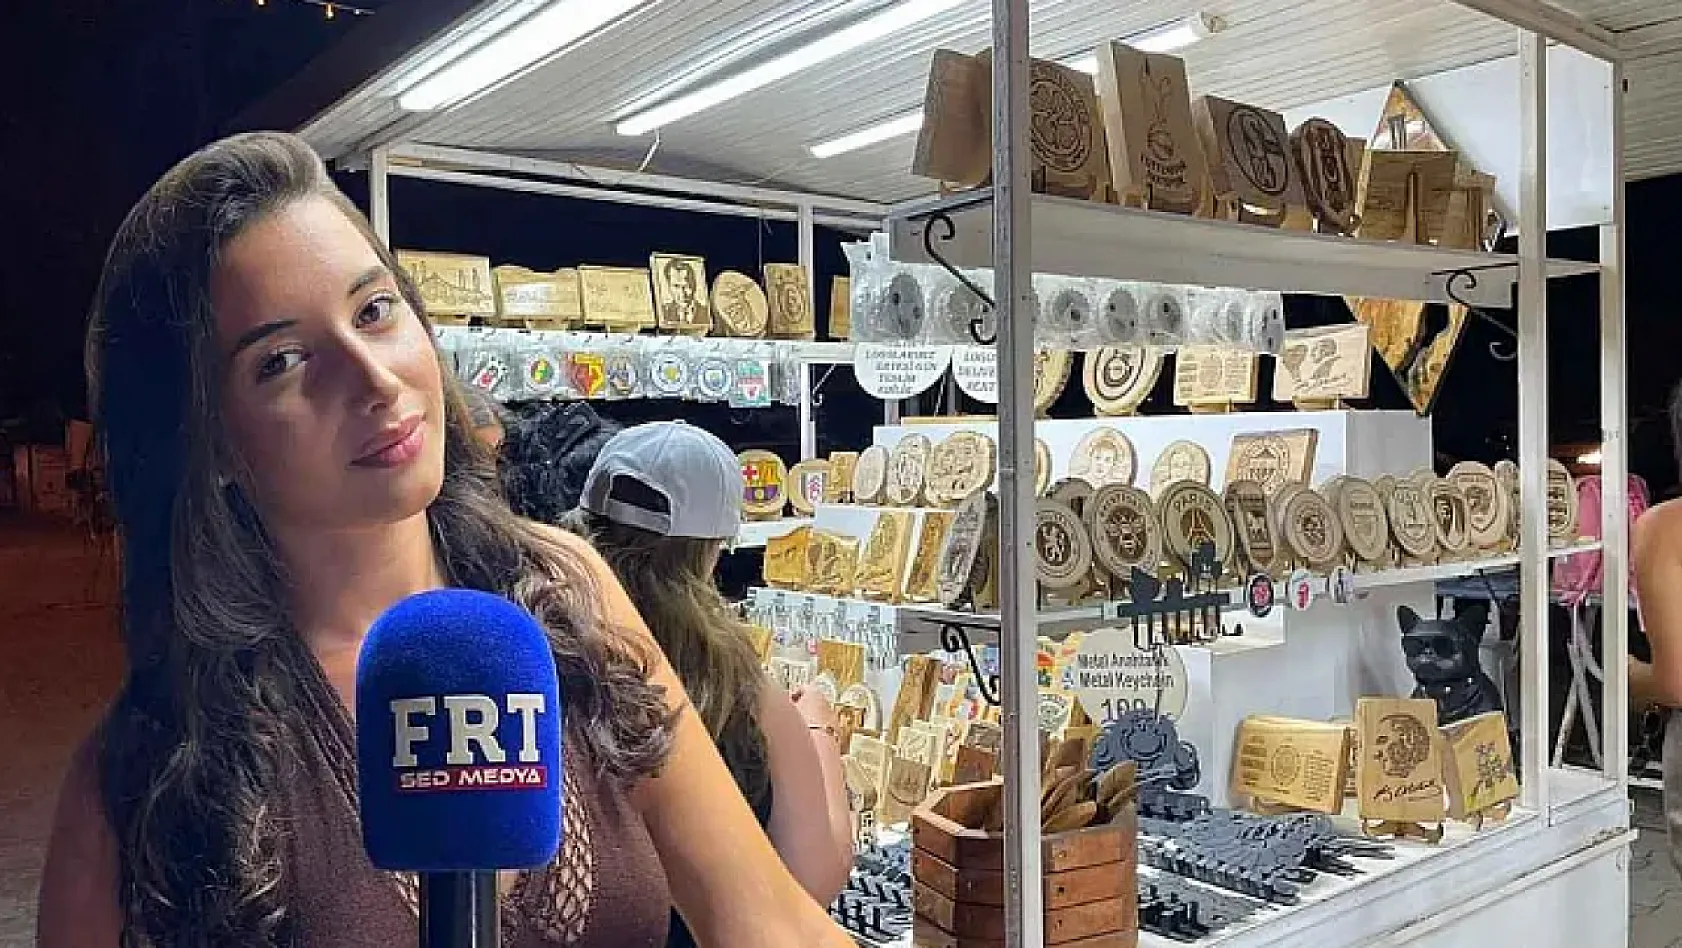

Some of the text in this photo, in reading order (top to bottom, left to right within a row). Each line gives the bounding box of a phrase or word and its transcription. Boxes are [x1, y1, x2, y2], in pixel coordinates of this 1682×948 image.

[1077, 653, 1109, 668] Metal
[1079, 672, 1113, 687] Metal
[390, 694, 546, 767] FRT
[400, 769, 541, 788] SED MEDYA
